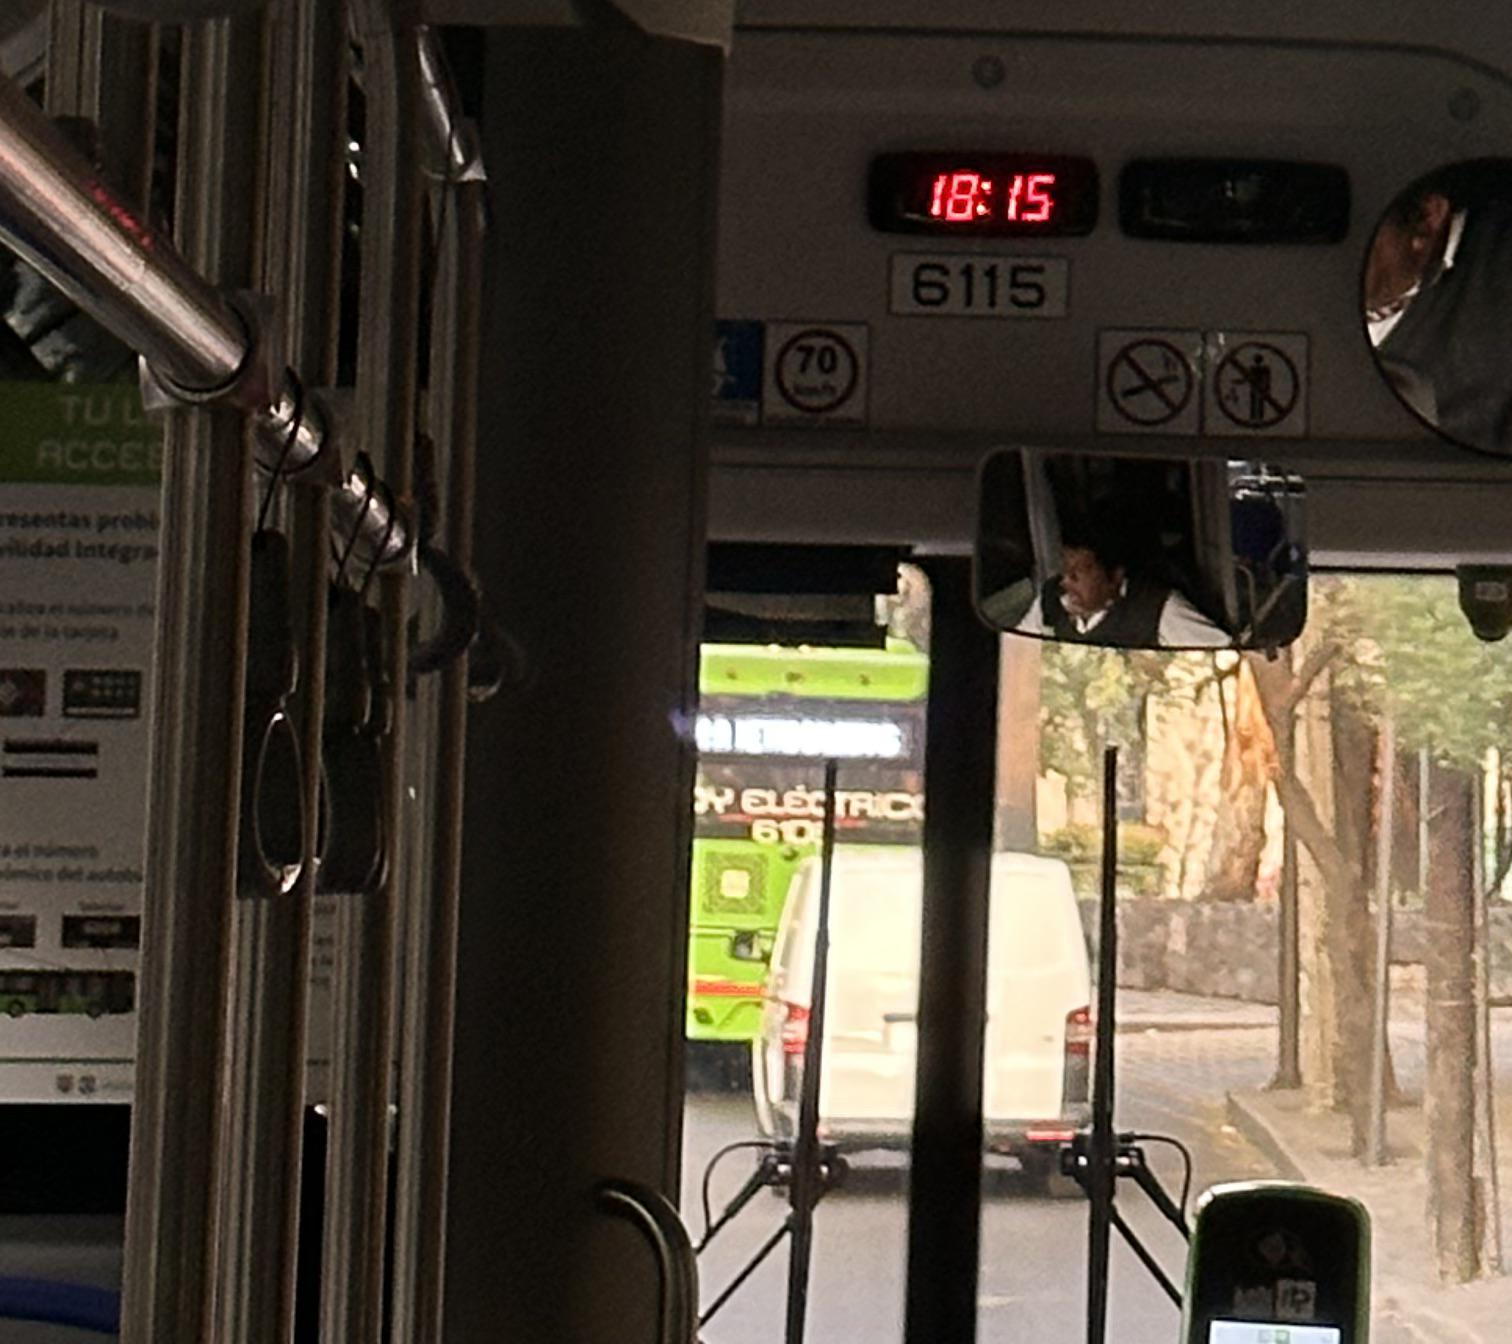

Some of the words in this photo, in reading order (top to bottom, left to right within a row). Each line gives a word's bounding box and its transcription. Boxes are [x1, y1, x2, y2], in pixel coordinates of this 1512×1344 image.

[929, 172, 1056, 223] 18:15
[911, 263, 1046, 309] 6115
[797, 345, 838, 374] 70
[62, 395, 112, 426] TU
